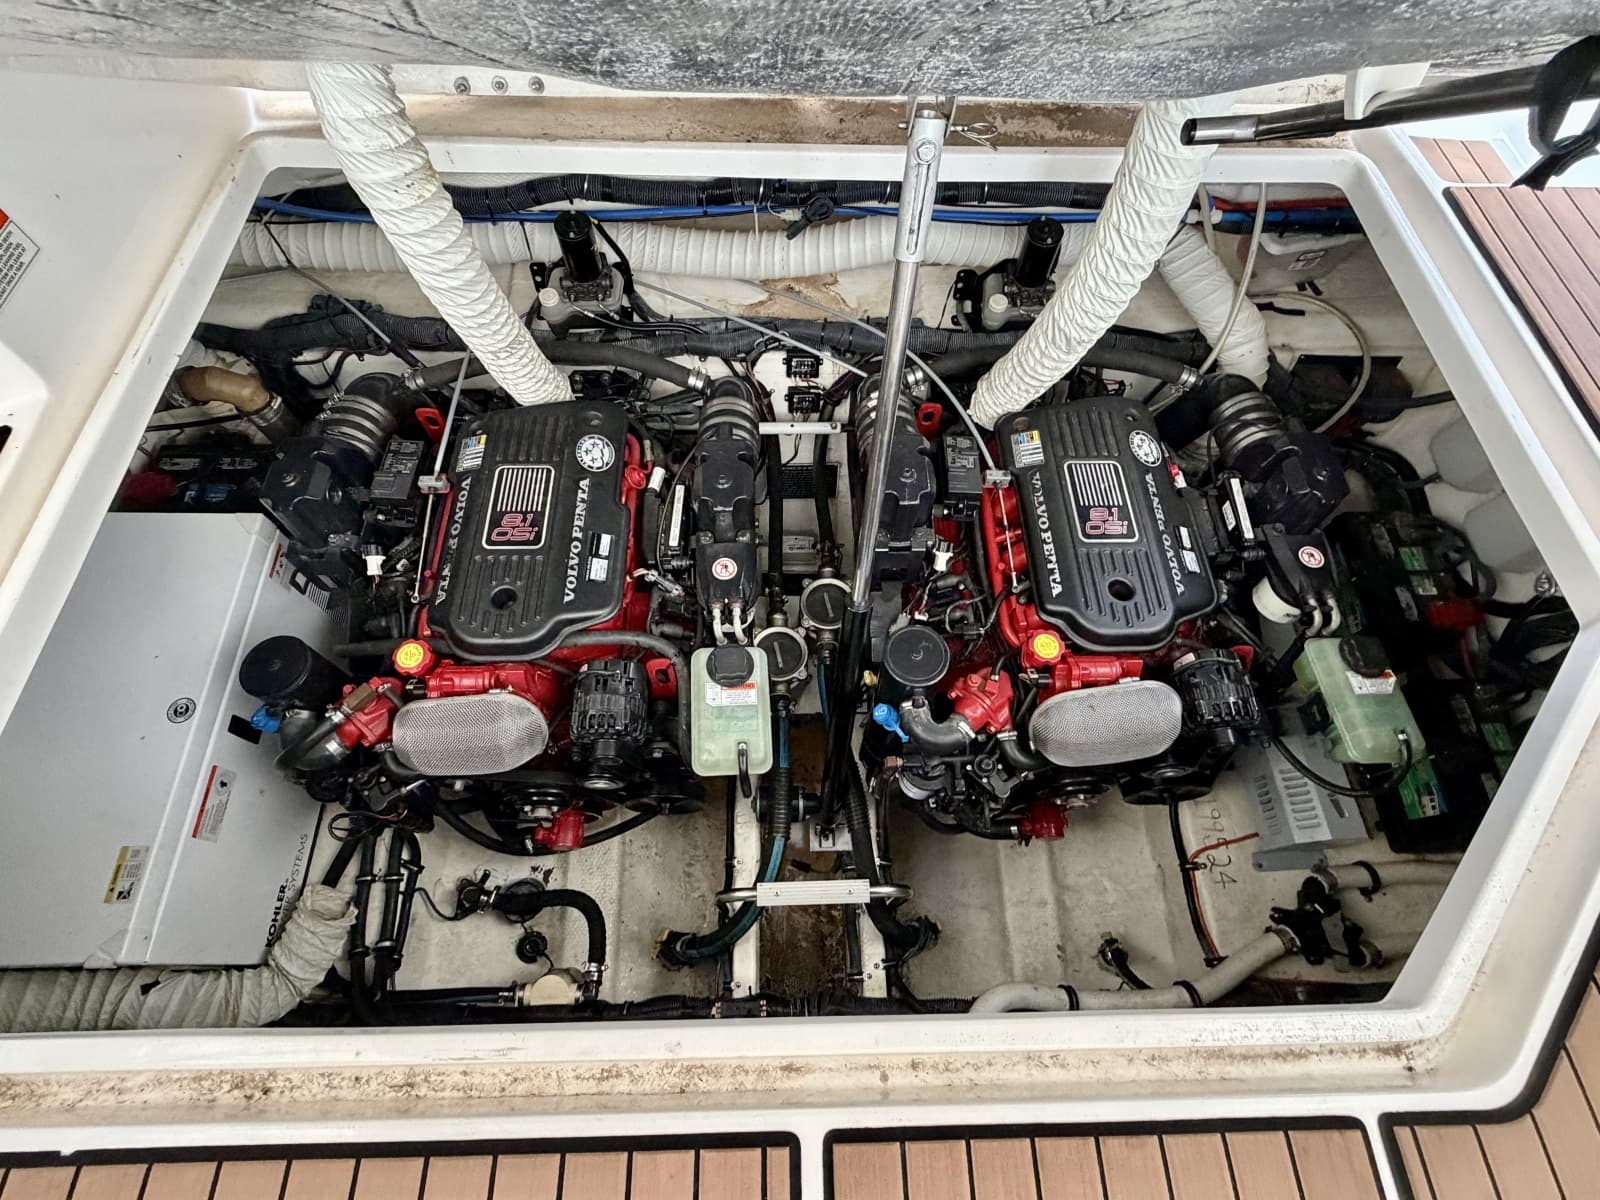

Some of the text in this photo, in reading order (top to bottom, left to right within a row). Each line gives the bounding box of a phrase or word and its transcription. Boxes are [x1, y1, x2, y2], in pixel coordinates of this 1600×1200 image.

[451, 476, 471, 535] VOLVO
[501, 513, 533, 527] 8.1
[1086, 520, 1128, 534] OSi
[1090, 507, 1118, 521] 8.1
[1145, 472, 1166, 531] PENTA
[491, 527, 538, 541] OSi
[563, 478, 590, 604] VOLVO PENTA
[1032, 471, 1062, 598] VOLVO PENTA
[1162, 534, 1185, 595] VOLVO
[288, 833, 308, 893] SYSTEMS
[265, 884, 288, 948] KOHLER
